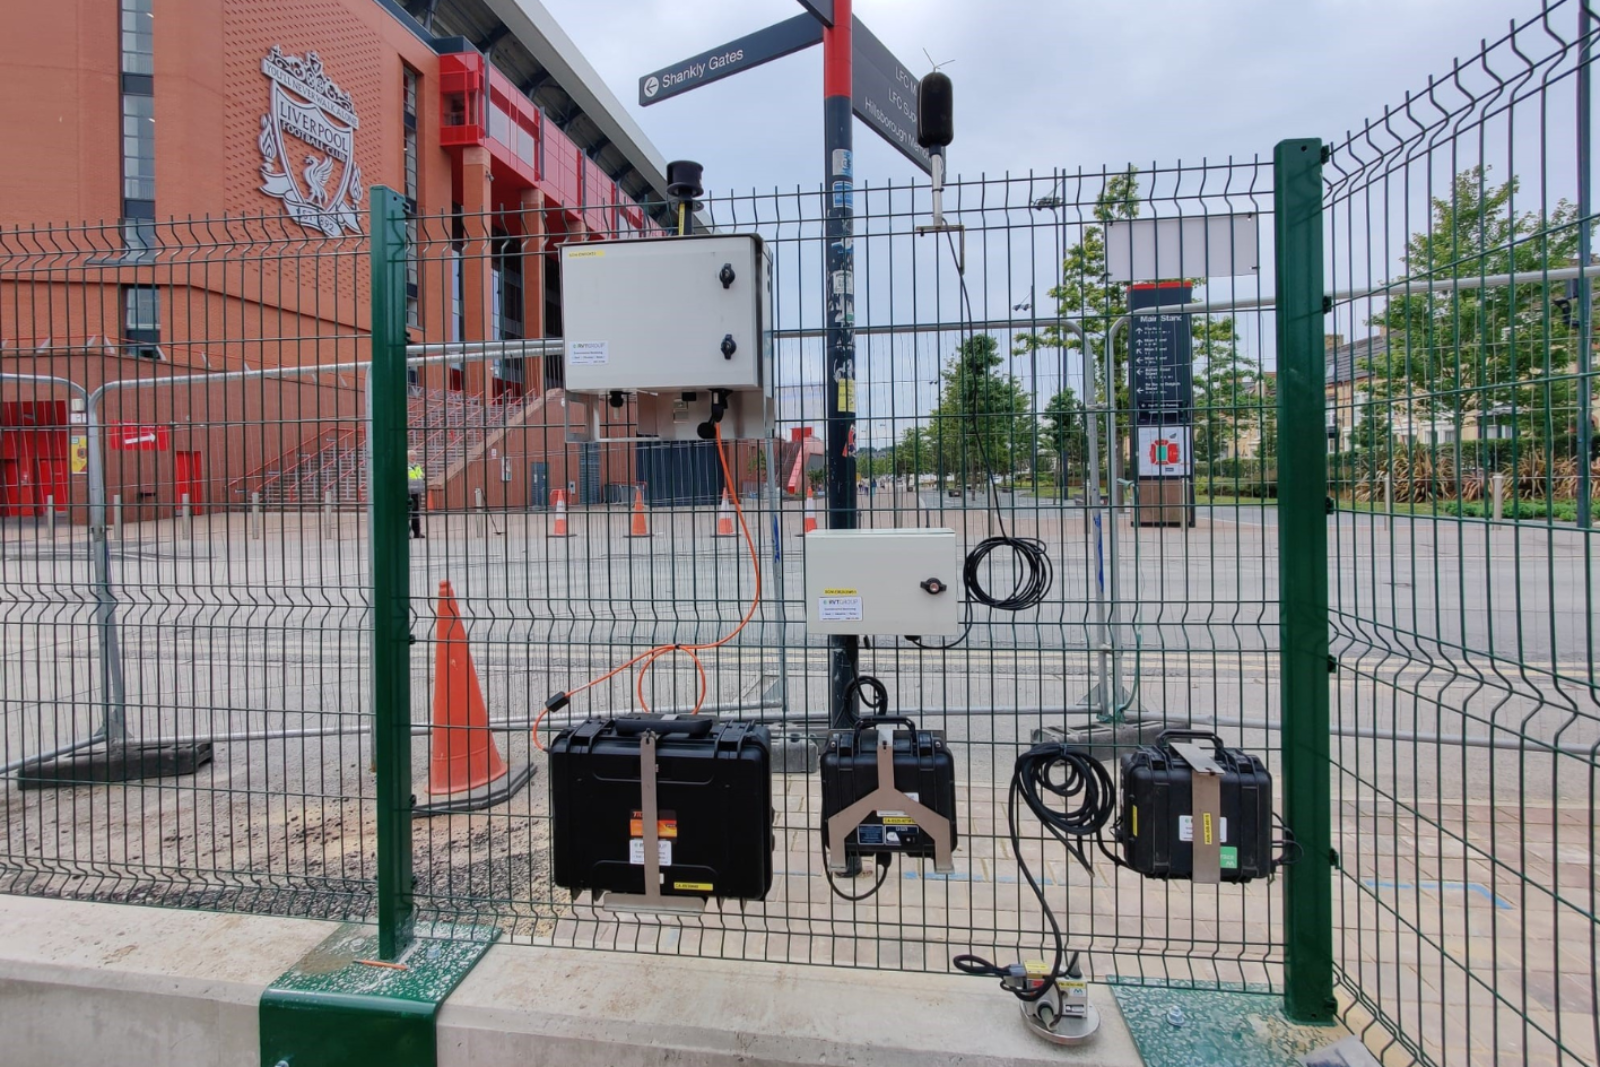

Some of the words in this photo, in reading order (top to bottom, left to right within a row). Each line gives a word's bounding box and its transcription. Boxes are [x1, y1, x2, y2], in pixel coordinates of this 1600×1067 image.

[662, 63, 706, 88] Shankly
[708, 49, 744, 70] Gates
[895, 65, 910, 89] LFC
[293, 79, 317, 101] NEVER
[316, 94, 336, 112] WALK
[336, 107, 358, 126] ALONE
[888, 87, 903, 110] LFC
[279, 101, 349, 153] LIVERPOOL
[281, 120, 325, 152] FOOTBALL
[864, 96, 907, 143] Hillsborough
